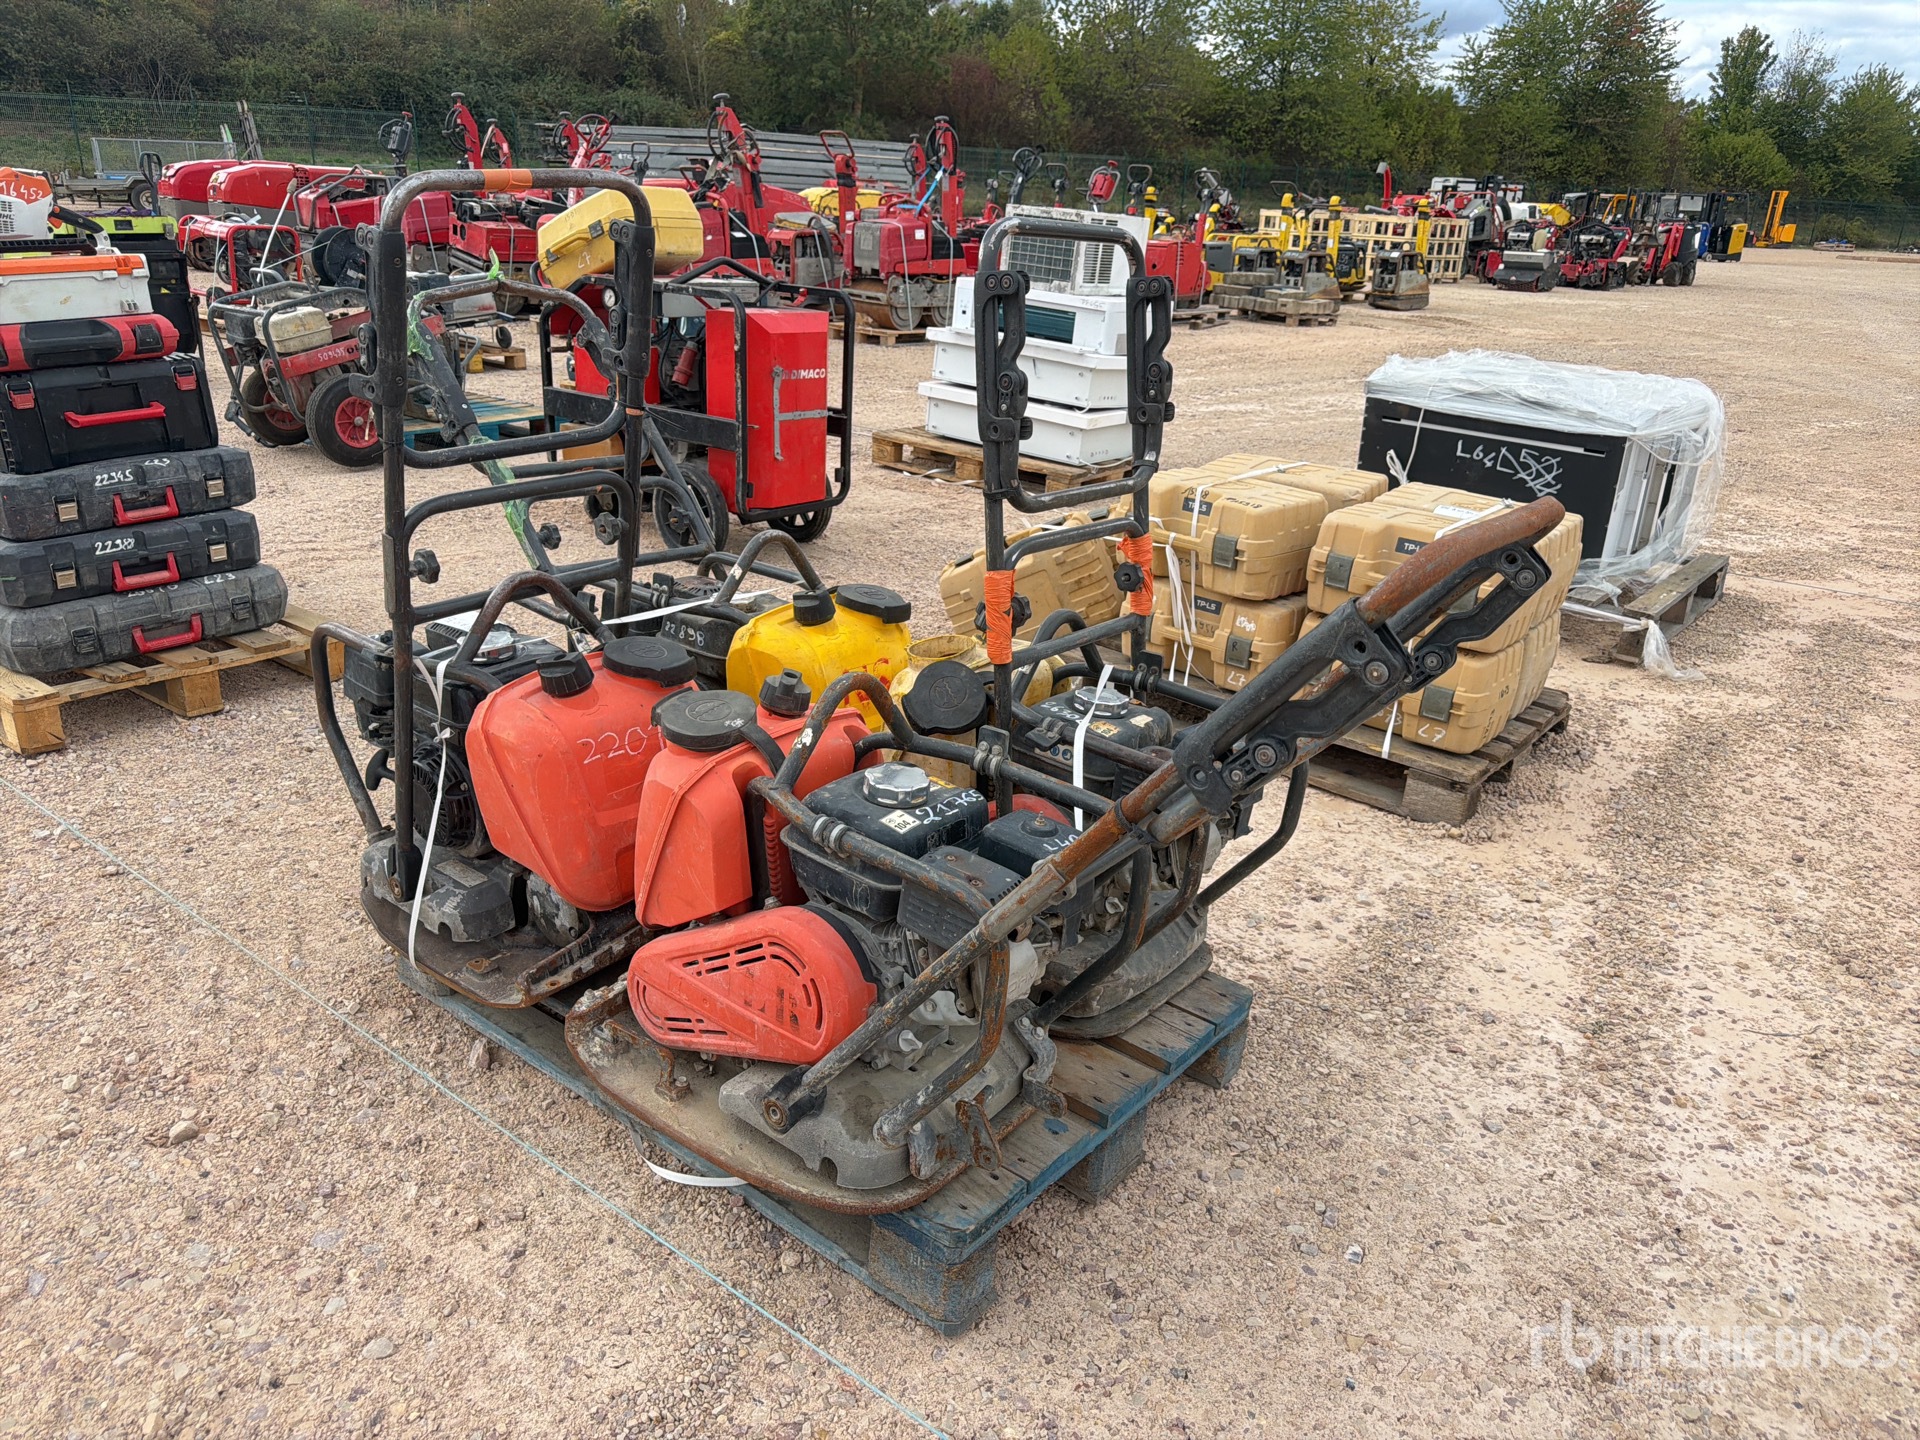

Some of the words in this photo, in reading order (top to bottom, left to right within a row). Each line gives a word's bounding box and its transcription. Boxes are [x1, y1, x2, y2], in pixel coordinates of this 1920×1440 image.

[791, 368, 826, 380] DIMACO
[1226, 670, 1246, 687] L7
[1417, 723, 1446, 743] L7
[894, 820, 912, 831] 104
